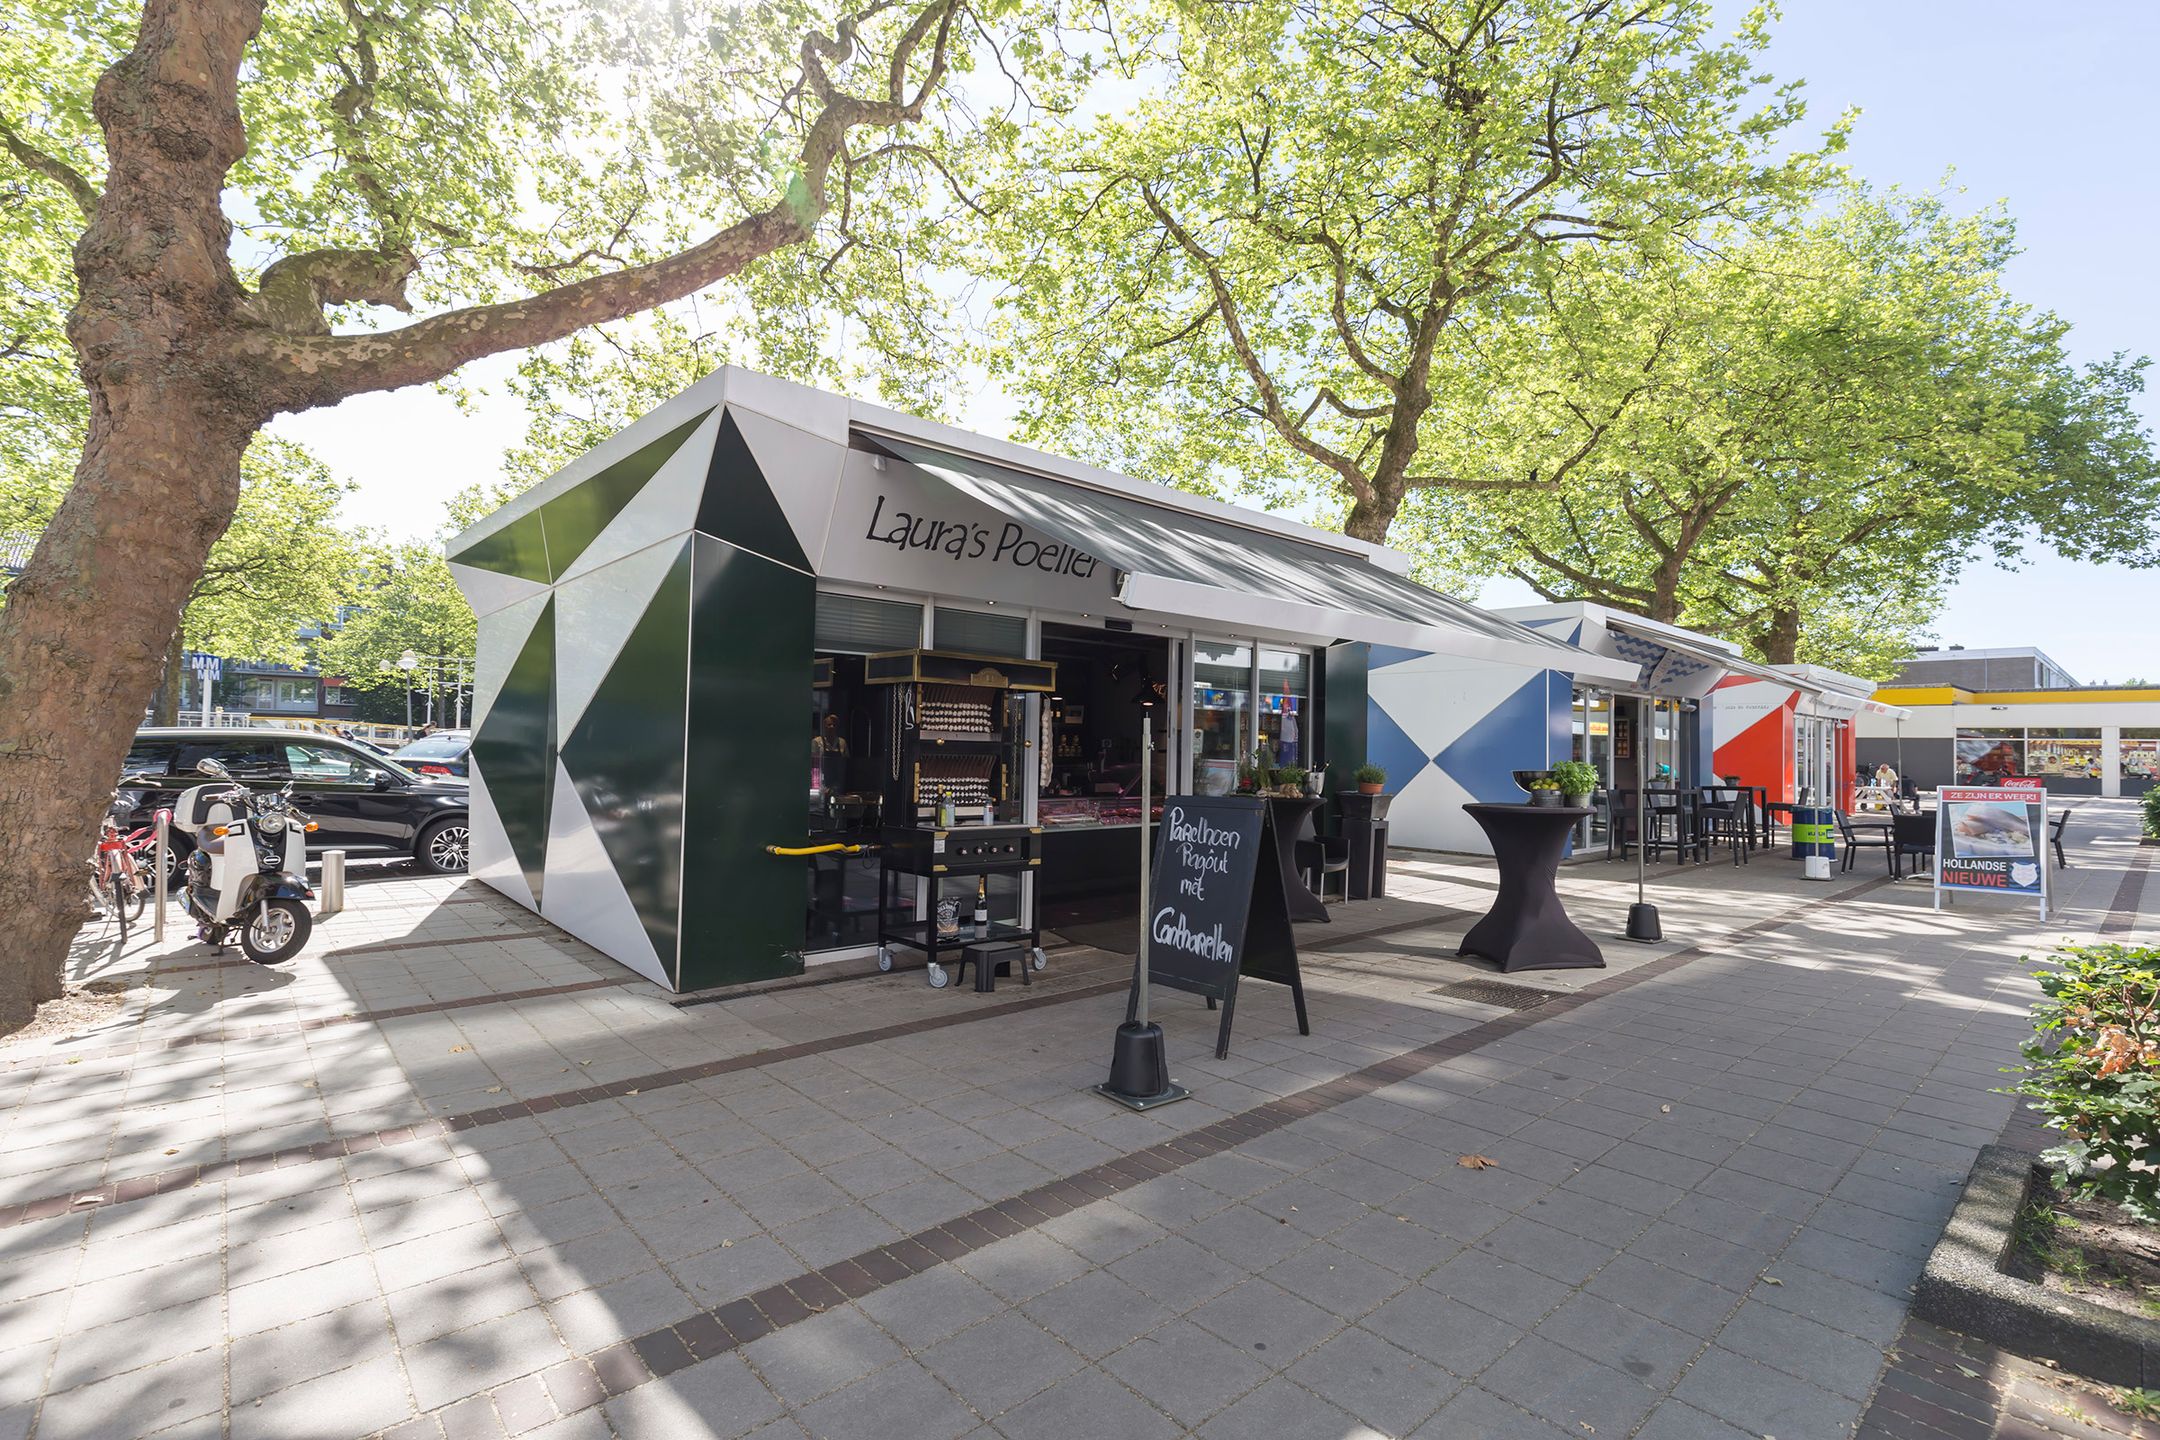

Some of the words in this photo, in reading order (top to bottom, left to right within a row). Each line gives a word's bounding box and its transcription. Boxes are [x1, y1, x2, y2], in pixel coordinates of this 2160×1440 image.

[866, 495, 989, 560] Laura's
[1950, 791, 1963, 799] ZE
[1965, 791, 1987, 799] ZIJN
[1988, 792, 2003, 800] ER
[2003, 792, 2037, 801] WEER!
[1943, 858, 2007, 872] HOLLANDSE
[1942, 870, 2007, 888] NIEUWE
